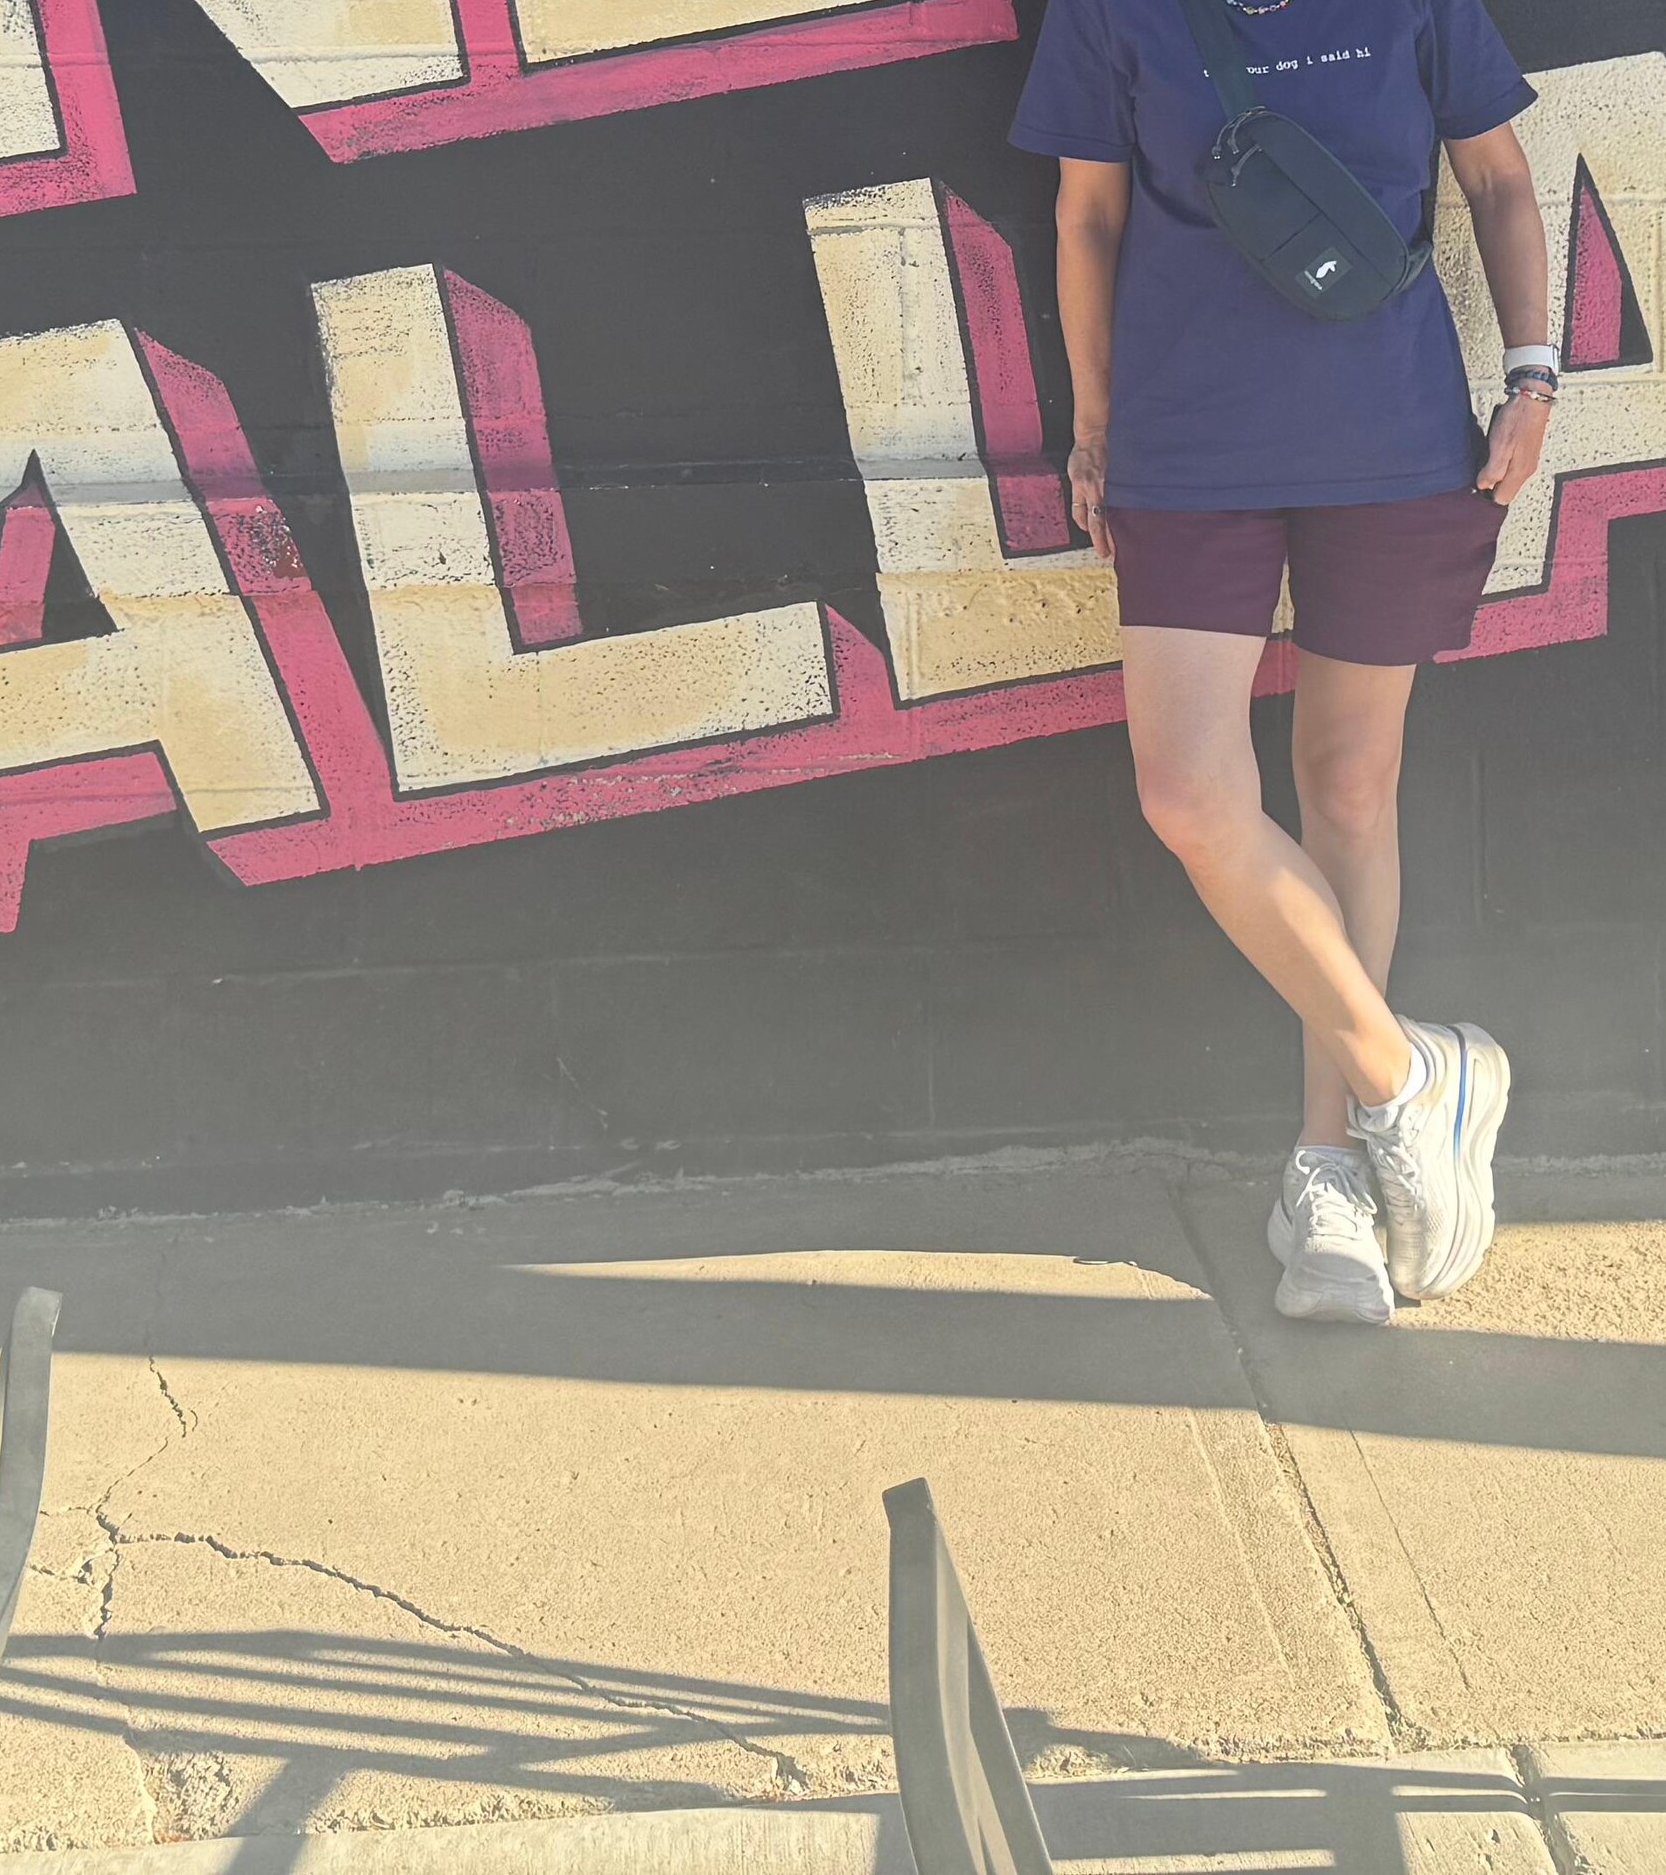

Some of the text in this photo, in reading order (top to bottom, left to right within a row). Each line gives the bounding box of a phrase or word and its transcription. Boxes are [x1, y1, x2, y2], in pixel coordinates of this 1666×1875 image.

[1275, 60, 1299, 71] dog
[1306, 55, 1314, 65] i
[1320, 49, 1351, 63] said
[1355, 46, 1372, 59] hi
